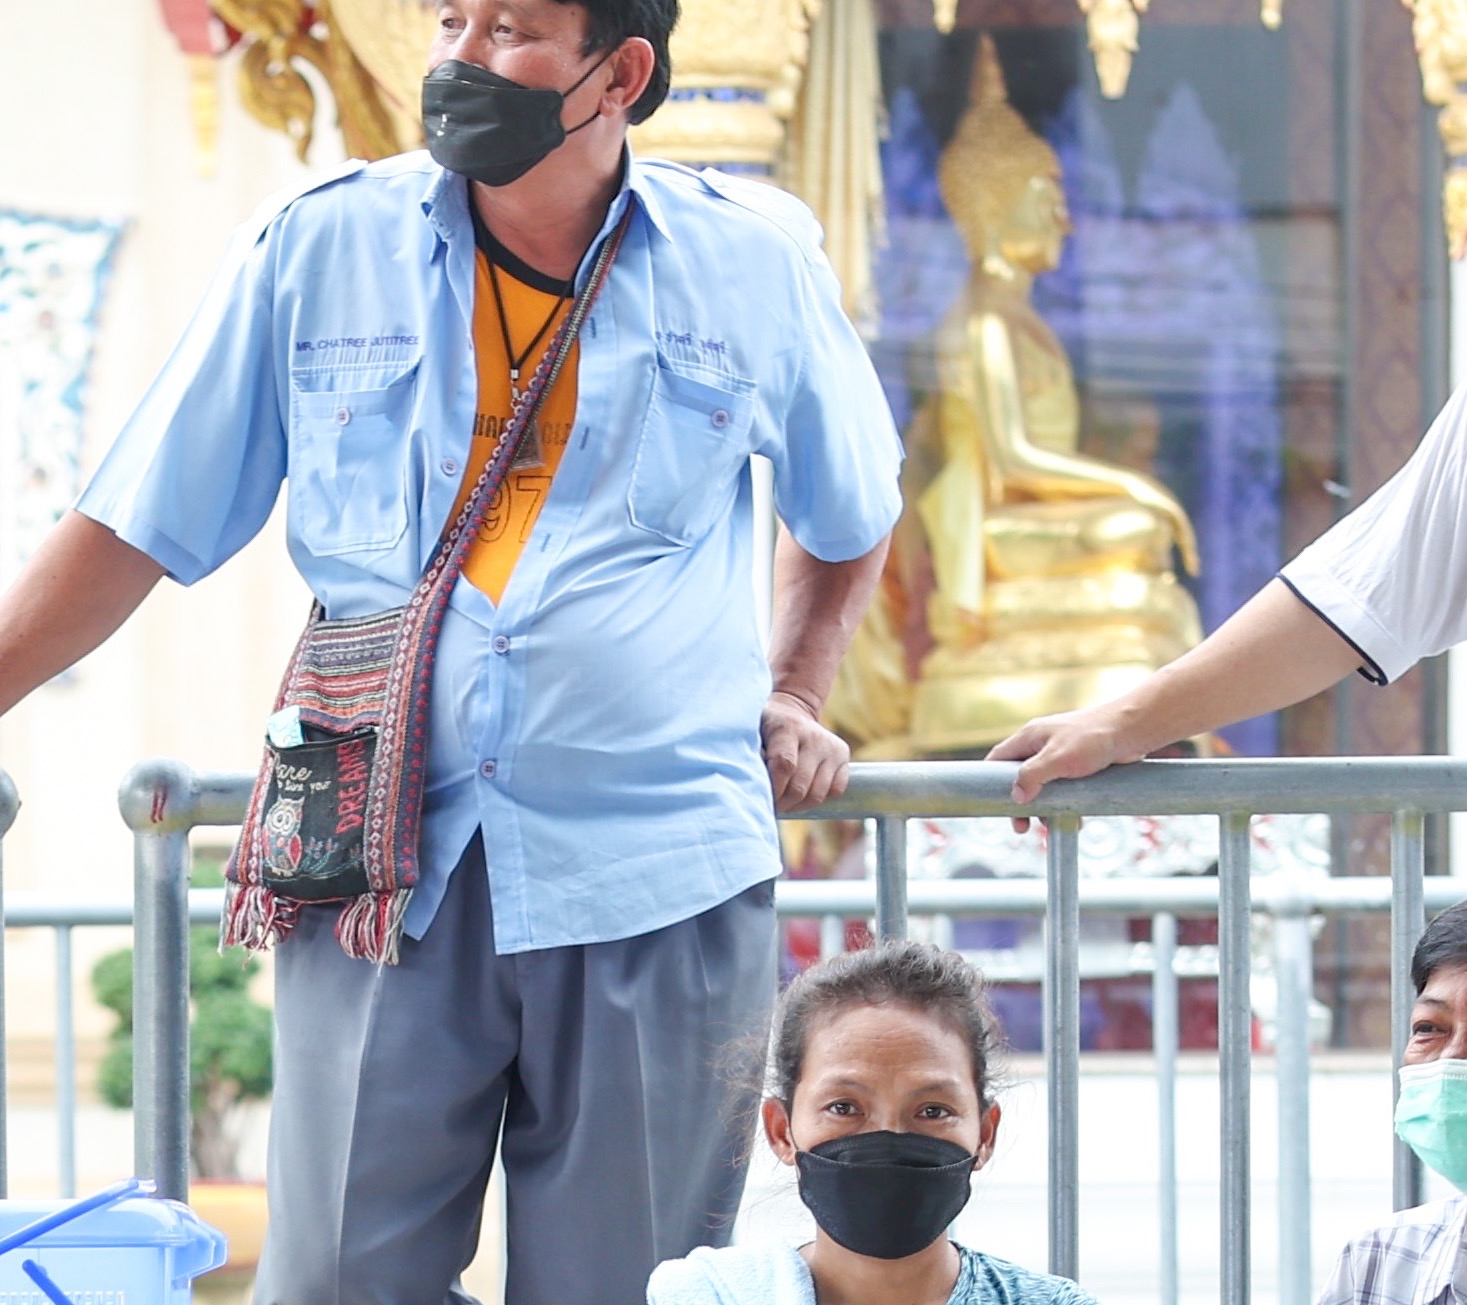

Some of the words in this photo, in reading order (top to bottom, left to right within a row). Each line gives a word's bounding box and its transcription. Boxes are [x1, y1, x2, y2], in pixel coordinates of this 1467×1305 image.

[296, 341, 315, 352] MR.
[318, 337, 367, 350] CHATREE
[335, 739, 369, 834] DREAMS
